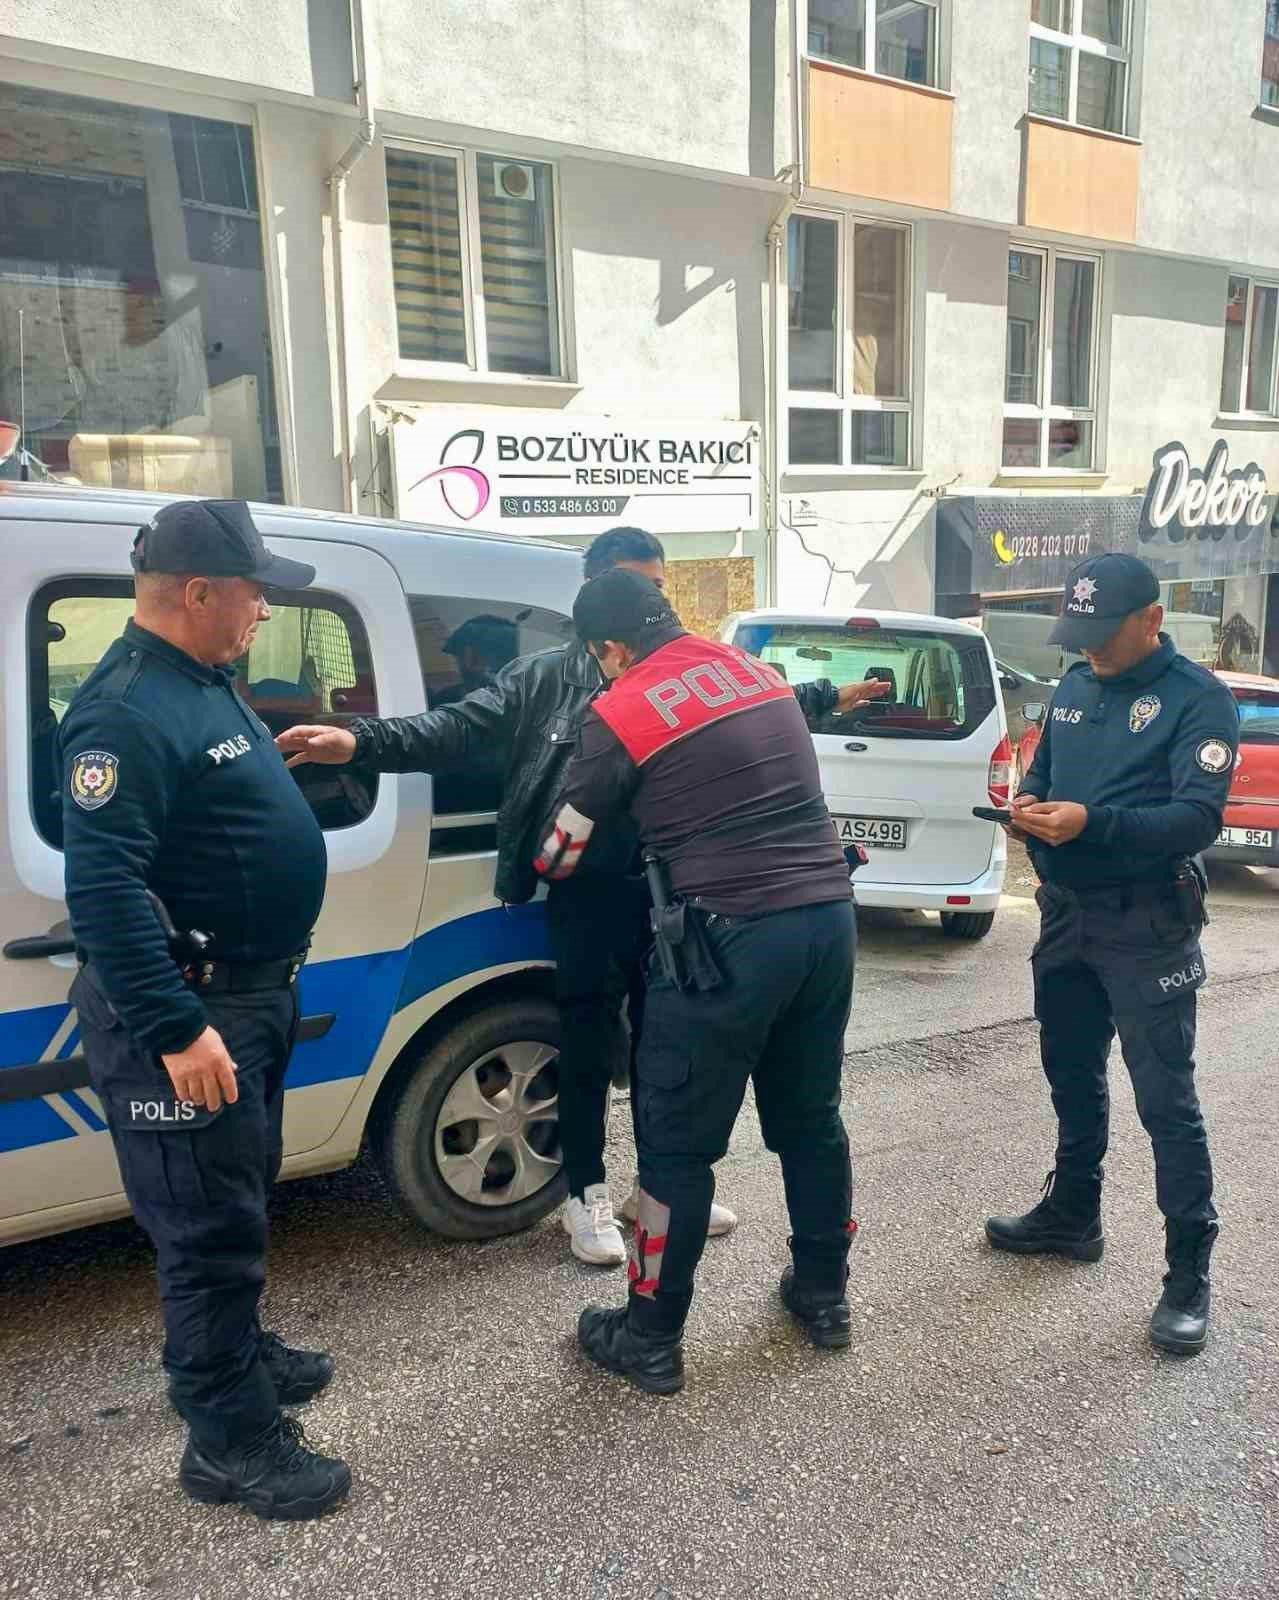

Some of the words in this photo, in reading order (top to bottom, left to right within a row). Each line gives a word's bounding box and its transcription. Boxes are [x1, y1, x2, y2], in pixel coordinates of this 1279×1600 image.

[497, 432, 650, 463] BOZÜYÜK
[659, 439, 751, 464] BAKICI
[575, 468, 689, 485] RESIDENCE
[1150, 444, 1268, 528] Dekor
[522, 499, 531, 513] 0
[534, 499, 557, 513] 533
[560, 499, 582, 513] 486
[585, 499, 599, 513] 63
[602, 499, 616, 513] 00
[1011, 535, 1039, 557] 0228
[1040, 535, 1060, 556] 202
[1063, 534, 1076, 555] 07
[1078, 532, 1090, 555] 07
[1246, 830, 1269, 846] 954
